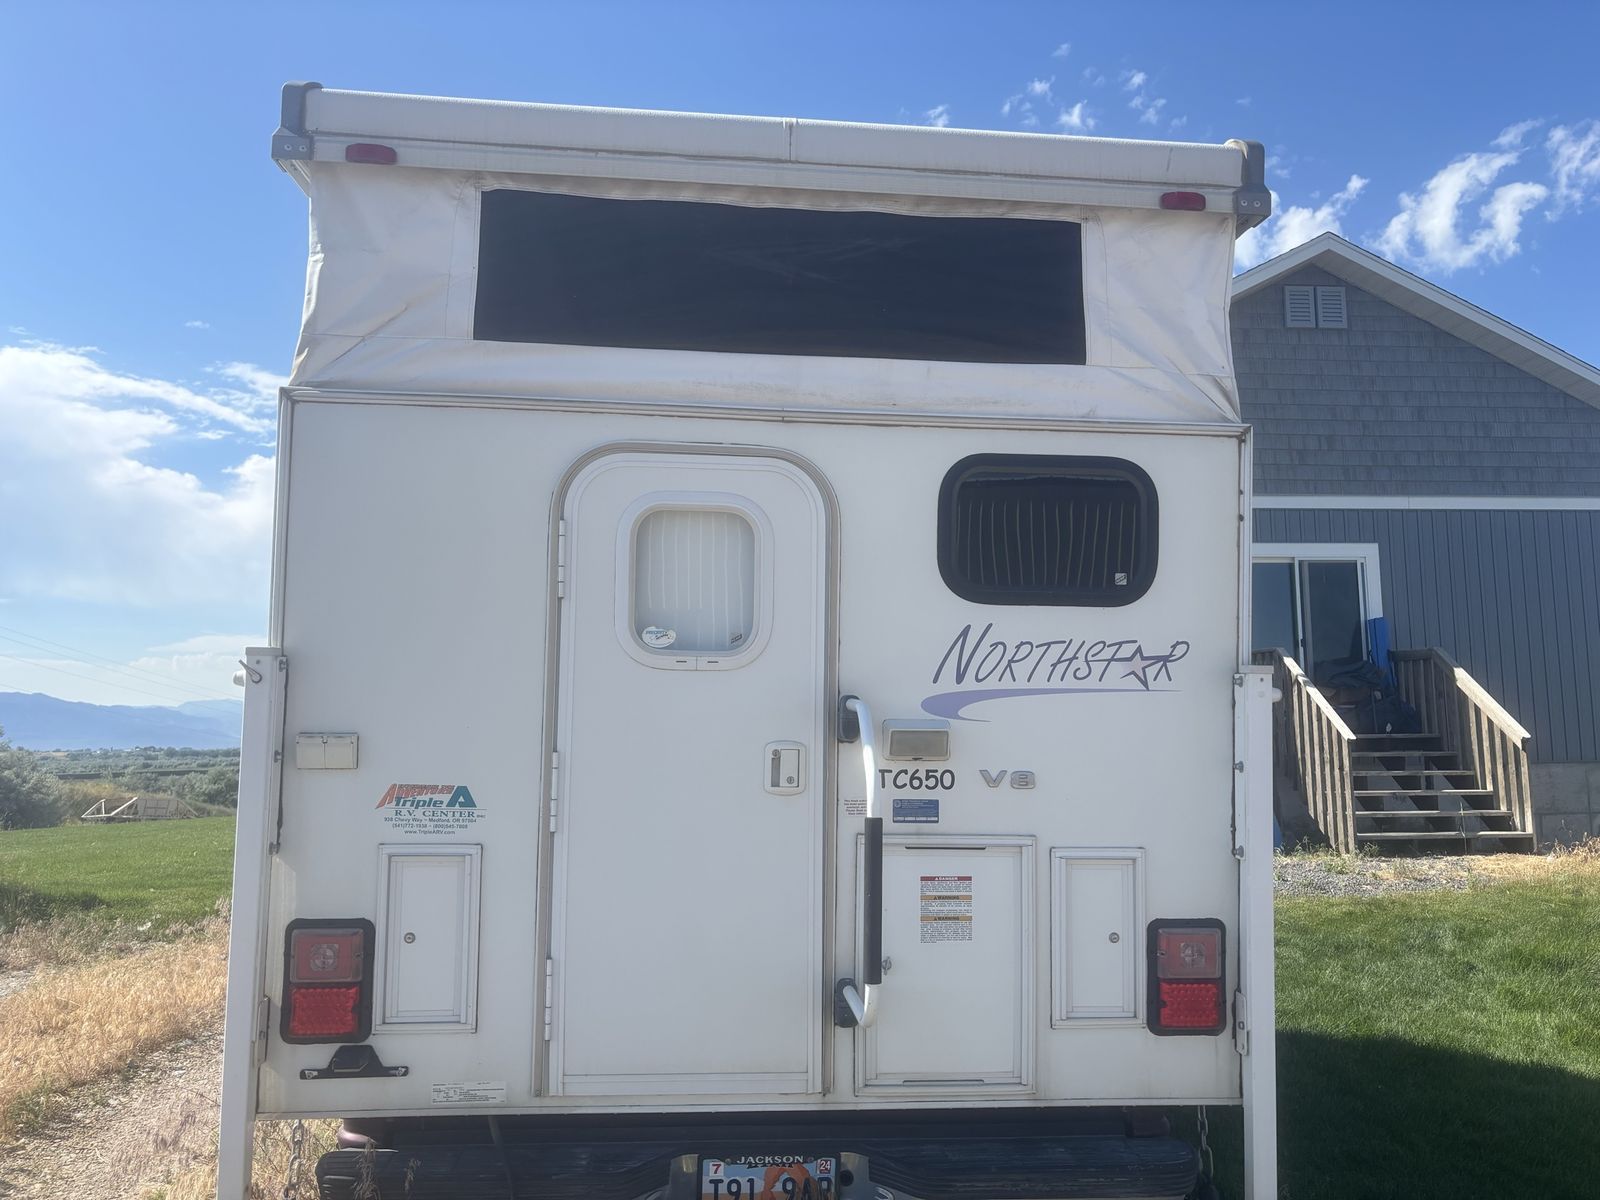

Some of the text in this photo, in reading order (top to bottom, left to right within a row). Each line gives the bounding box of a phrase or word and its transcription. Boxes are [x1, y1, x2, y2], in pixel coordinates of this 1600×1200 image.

[878, 768, 956, 790] TC650
[979, 769, 1036, 790] V8
[394, 785, 478, 809] Triple A
[394, 809, 416, 817] R.V.
[422, 810, 475, 818] CENTER
[737, 1155, 804, 1164] JACKSON
[820, 1159, 831, 1171] 24
[712, 1163, 721, 1174] 7
